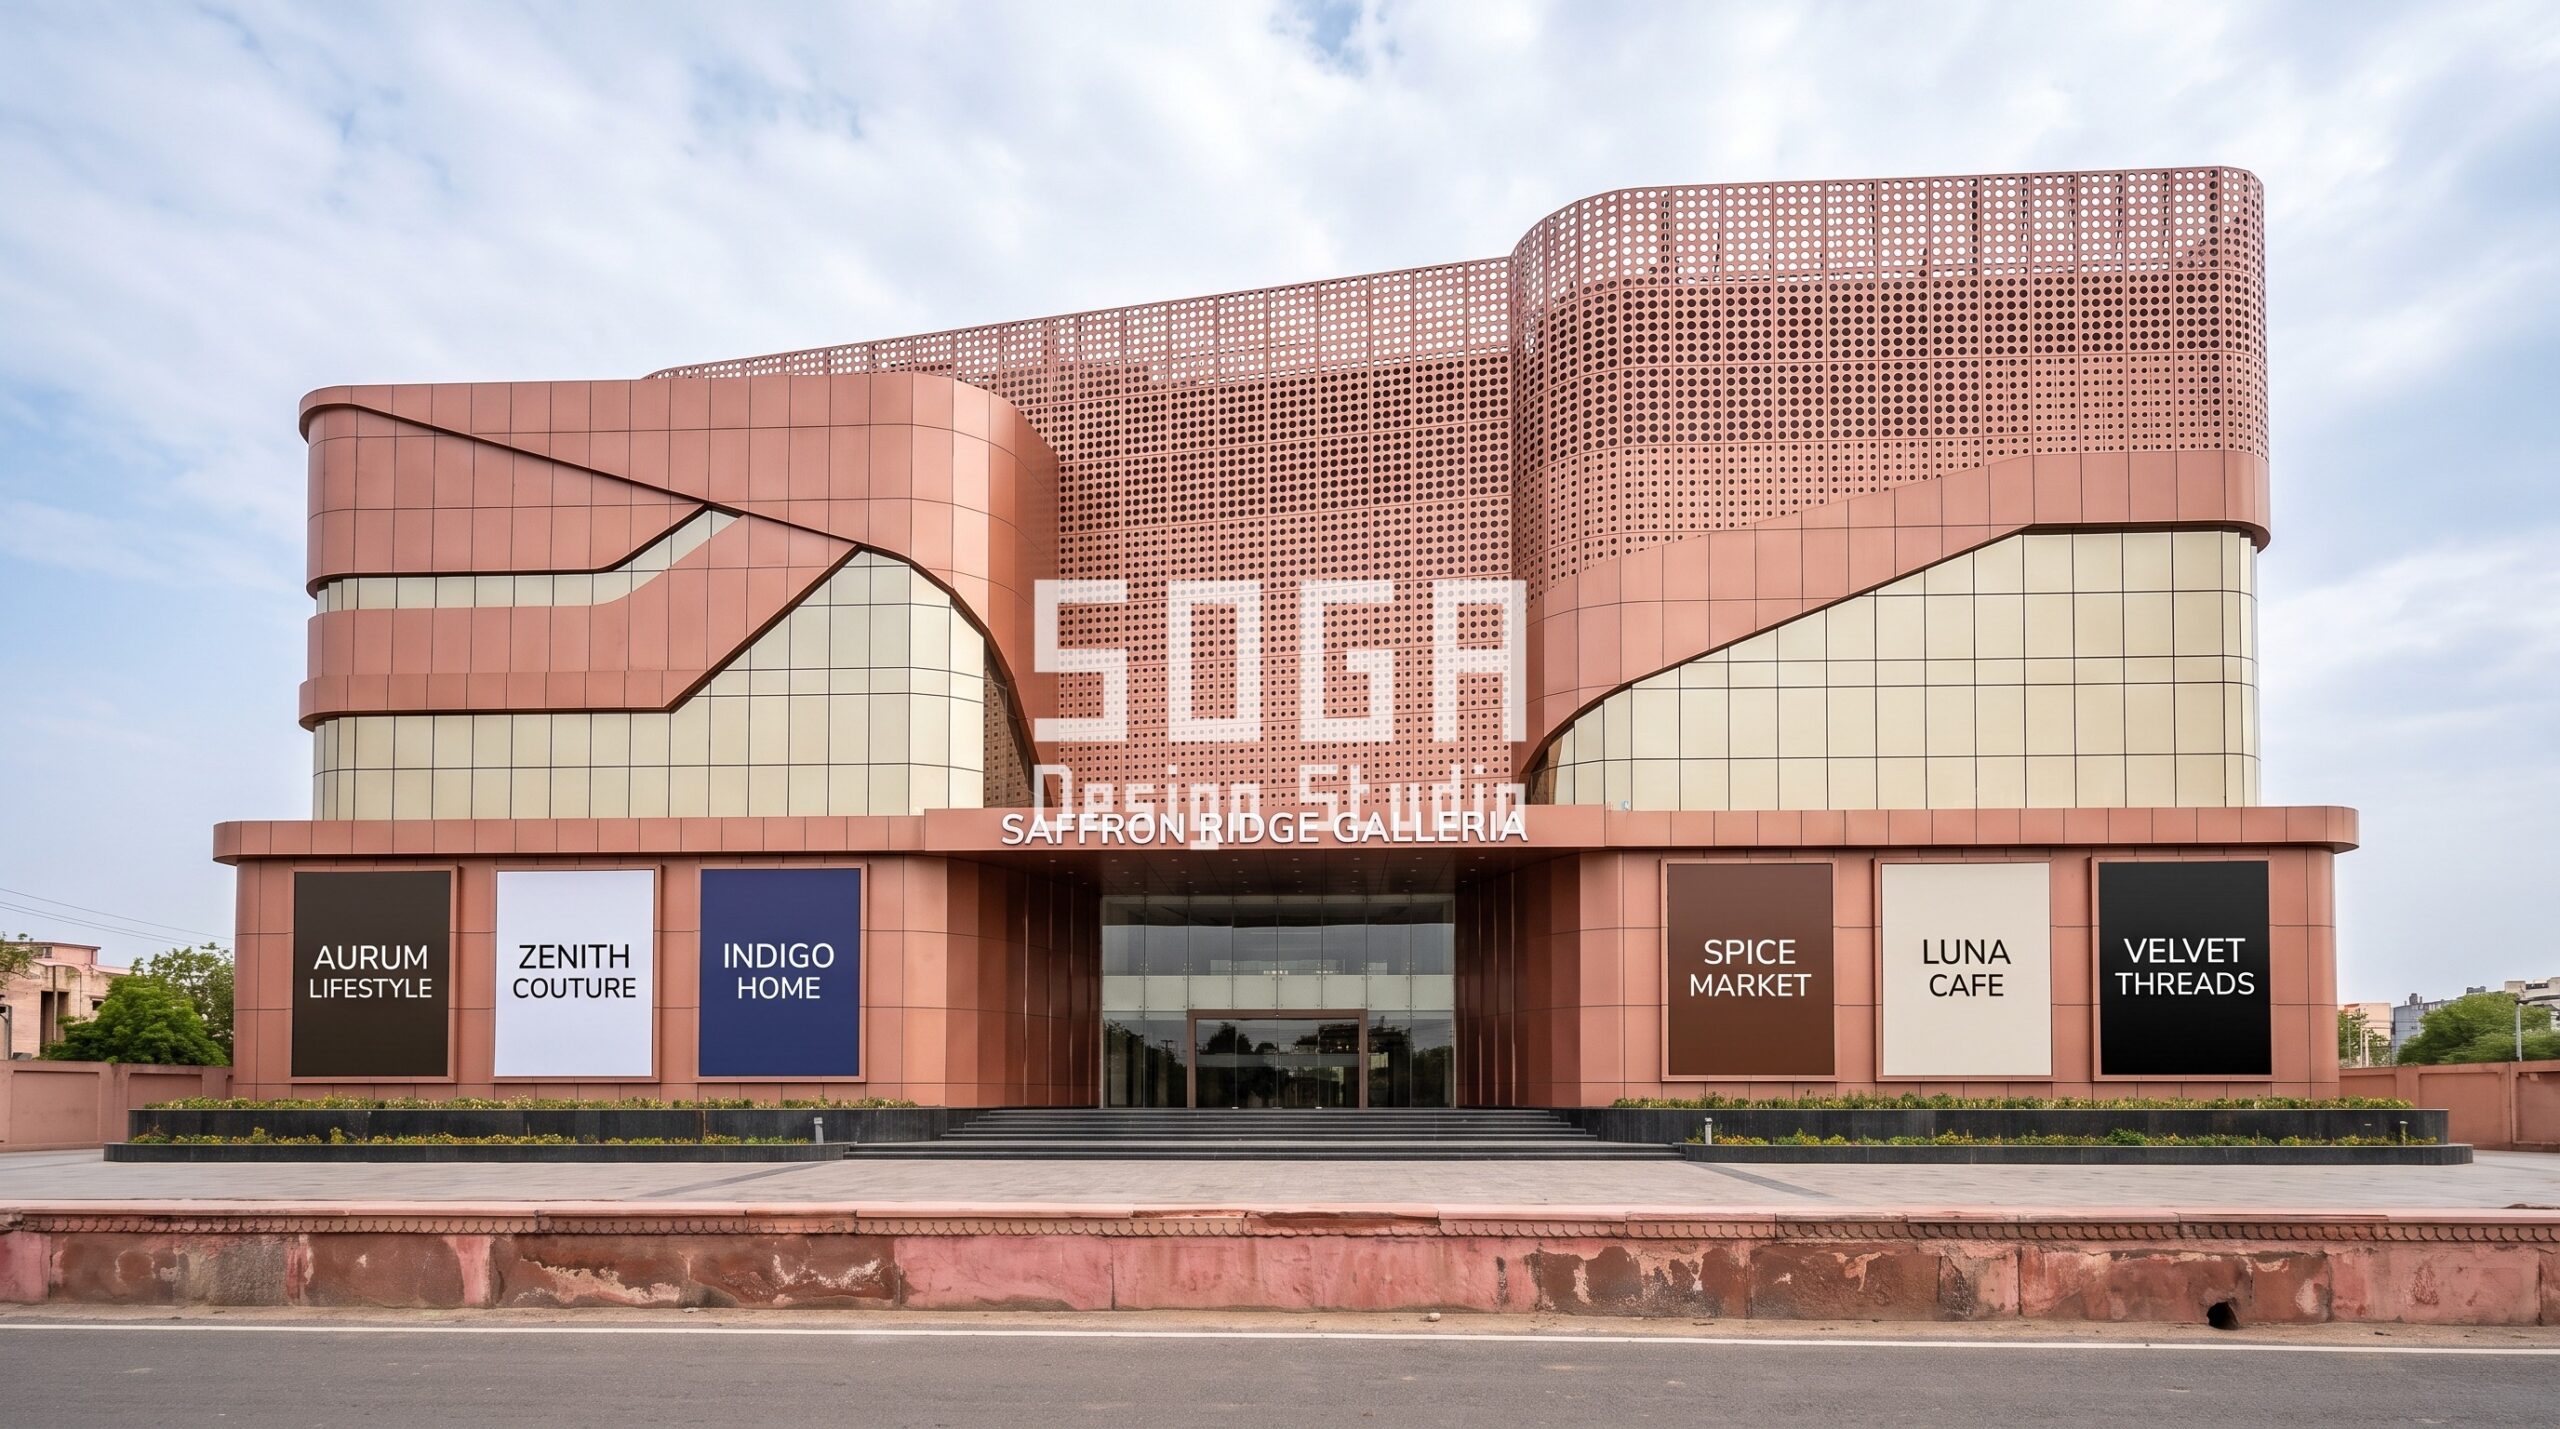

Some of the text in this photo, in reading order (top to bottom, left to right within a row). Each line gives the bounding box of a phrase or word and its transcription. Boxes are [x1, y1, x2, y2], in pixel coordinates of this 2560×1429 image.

[1001, 810, 1529, 846] SAFFRON RIDGE GALLERIA
[314, 945, 428, 970] AURUM
[519, 944, 630, 969] ZENITH
[725, 943, 835, 968] INDIGO
[1704, 939, 1796, 965] SPICE
[1923, 939, 2011, 965] LUNA
[2123, 938, 2246, 963] VELVET
[310, 977, 432, 999] LIFESTYLE
[513, 977, 636, 999] COUTURE
[738, 977, 821, 999] HOME
[1690, 973, 1812, 997] MARKET
[1930, 973, 2004, 998] CAFE
[2115, 972, 2255, 996] THREADS
